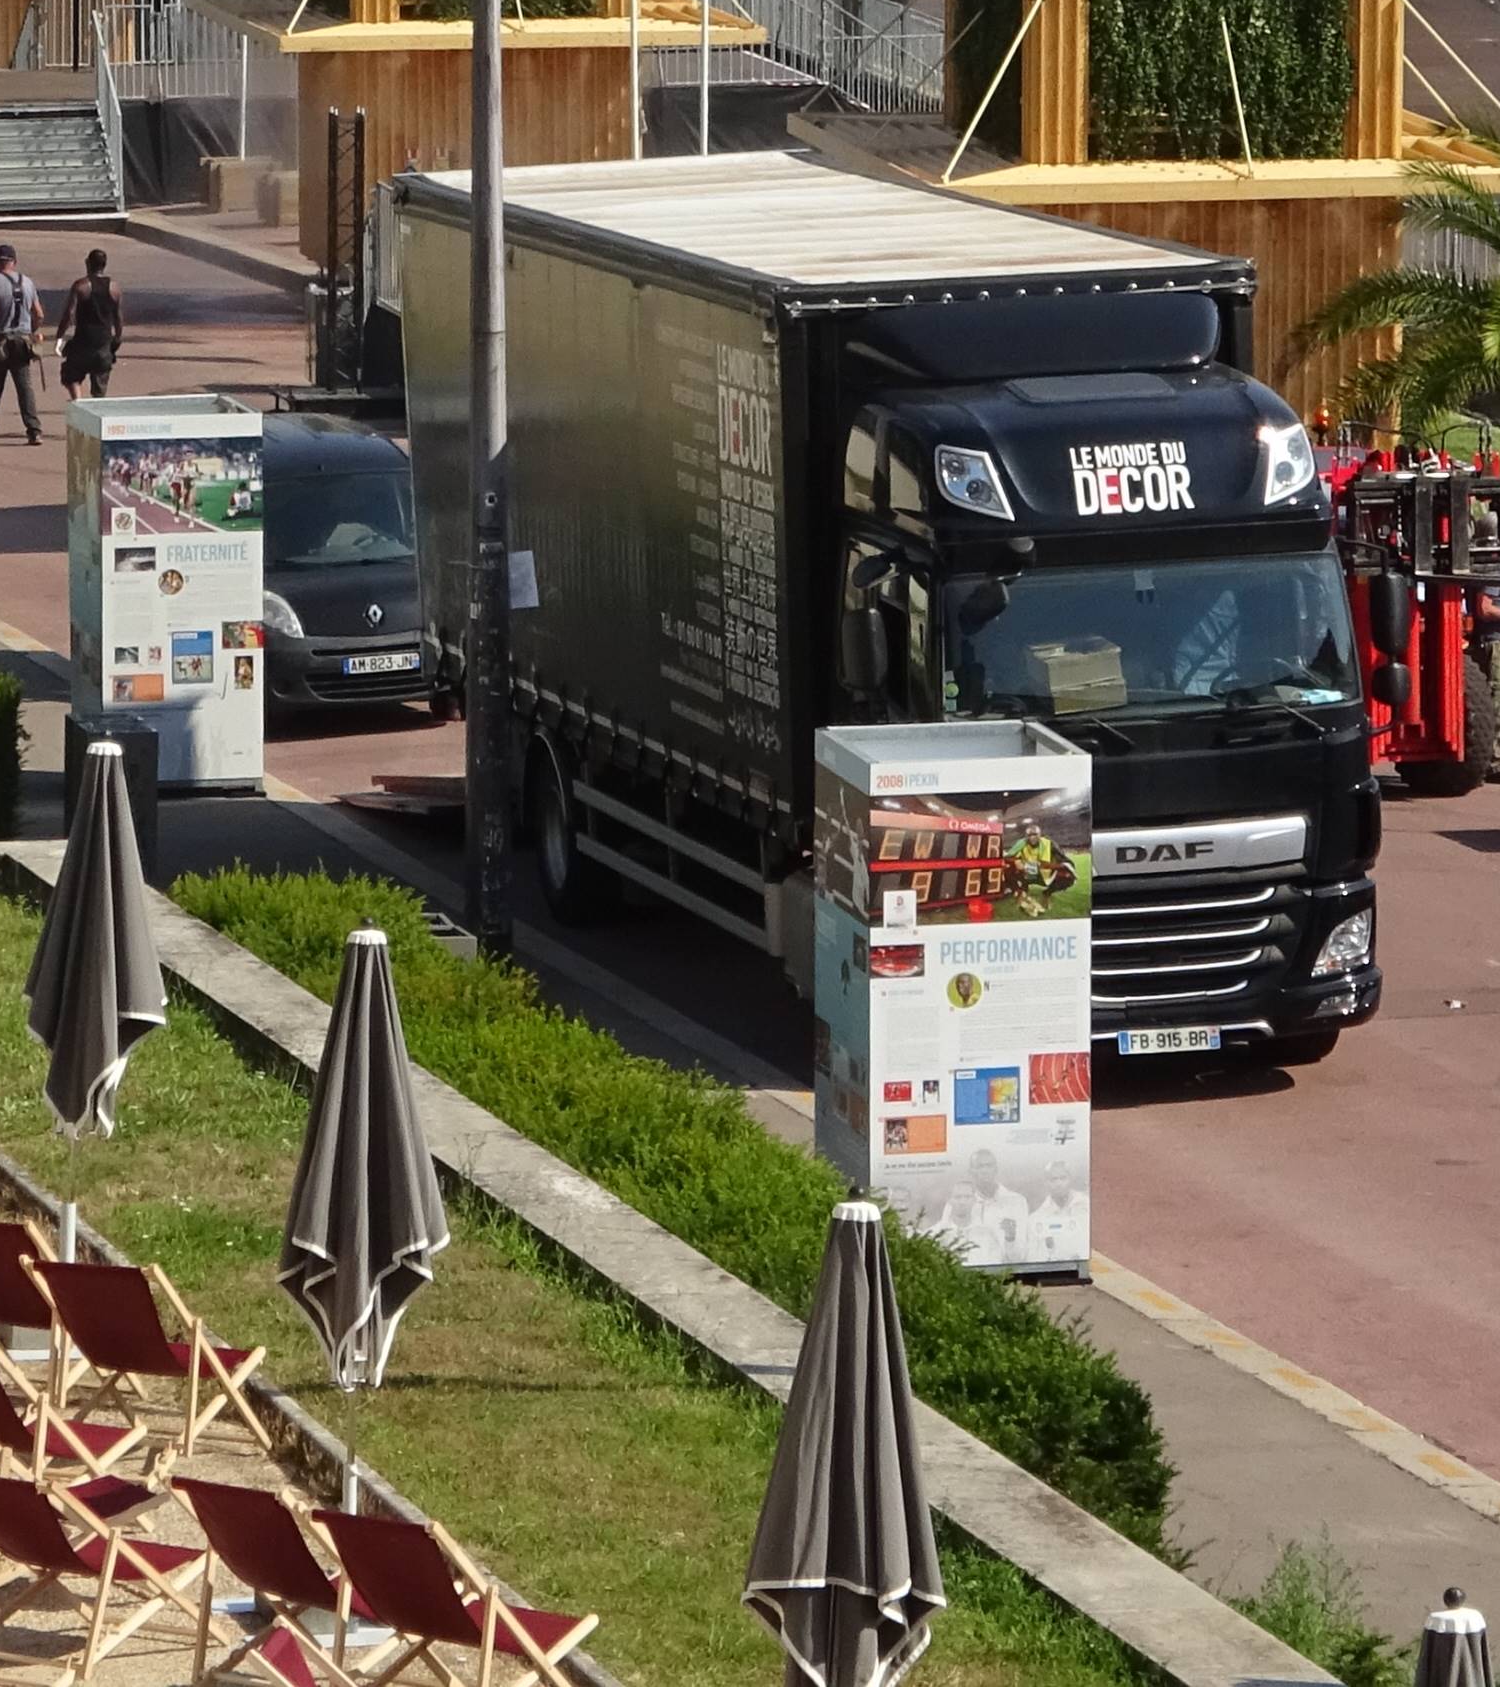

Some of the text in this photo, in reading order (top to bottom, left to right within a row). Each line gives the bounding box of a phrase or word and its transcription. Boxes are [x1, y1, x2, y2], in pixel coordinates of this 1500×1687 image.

[717, 383, 773, 477] DECOR
[1069, 441, 1187, 470] LE MONDE DU
[1073, 464, 1196, 516] DECOR
[166, 541, 248, 564] FRATERNITÉ
[876, 775, 904, 789] 2008
[1116, 841, 1214, 864] DAF
[940, 935, 1077, 965] PERFORMANCE
